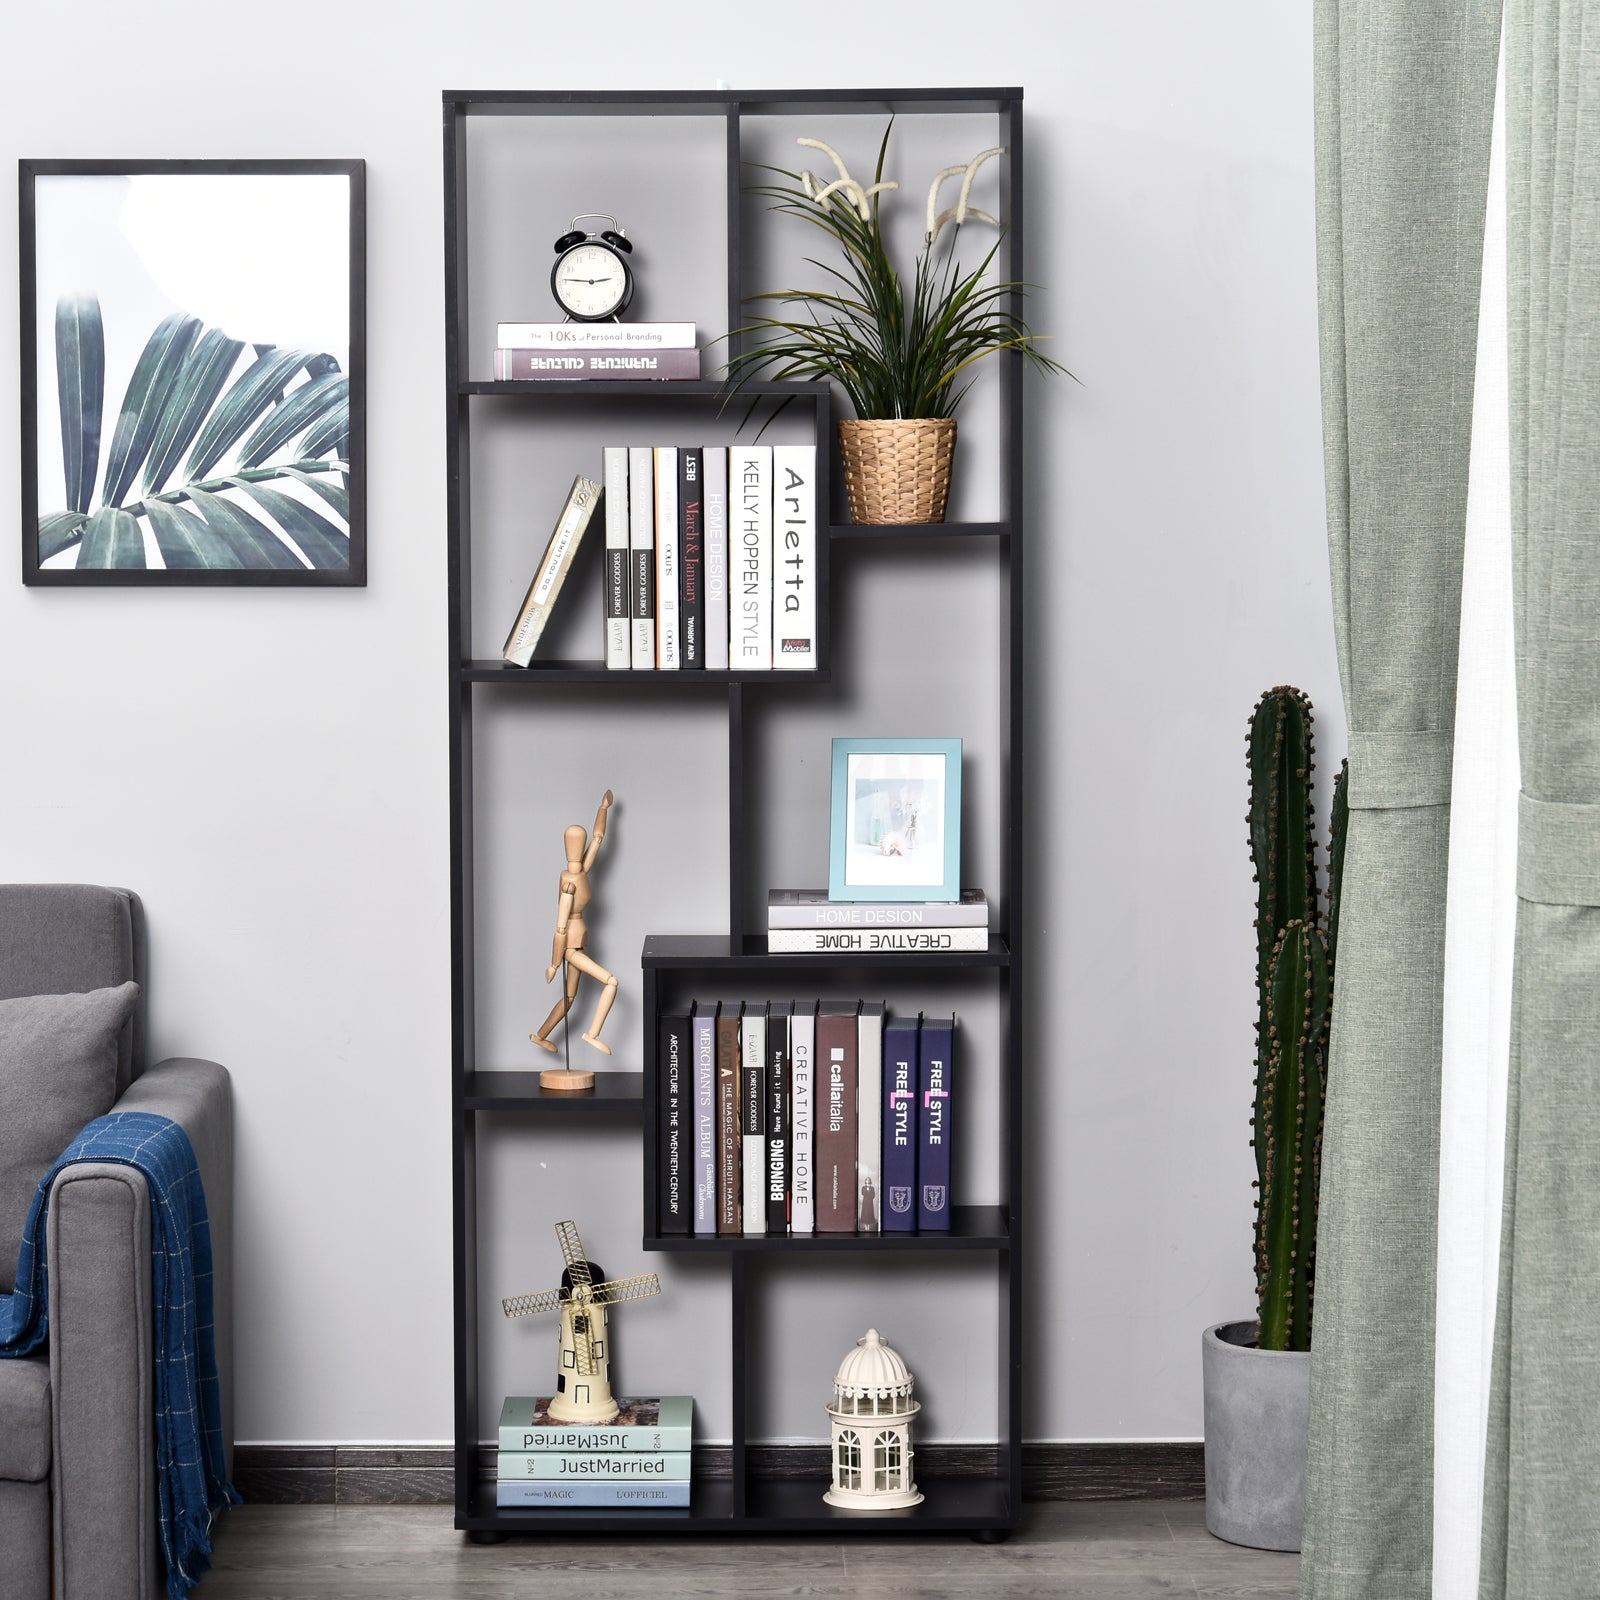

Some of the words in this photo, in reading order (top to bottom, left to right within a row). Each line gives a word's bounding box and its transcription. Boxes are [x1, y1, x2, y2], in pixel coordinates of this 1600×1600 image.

[549, 331, 576, 342] 10Ks
[586, 332, 623, 341] Personal
[626, 332, 662, 342] Branding
[531, 357, 584, 369] CULTURE
[686, 456, 696, 481] BEST
[743, 460, 759, 514] KELLY
[686, 502, 699, 541] March
[710, 494, 722, 538] HOME
[686, 544, 698, 554] &
[743, 520, 759, 594] HOPPEN
[785, 467, 806, 613] Arletta
[542, 578, 550, 591] DO
[549, 560, 558, 576] YOU
[556, 540, 566, 558] LIKE
[564, 529, 571, 538] IT
[710, 543, 722, 600] DESIGN
[684, 556, 699, 604] January
[743, 601, 758, 656] STYLE
[816, 911, 860, 922] HOME
[865, 910, 922, 922] DESIGN
[816, 935, 862, 948] HOME
[870, 935, 951, 948] CREATIVE
[670, 1034, 678, 1094] ARCHITECTURE
[700, 1028, 710, 1106] MERCHANTS
[774, 1051, 782, 1077] lacking
[896, 1062, 908, 1098] FREE
[930, 1060, 942, 1097] FREE
[670, 1098, 678, 1107] IN
[774, 1082, 781, 1090] it
[796, 1046, 808, 1140] CREATIVE
[830, 1064, 844, 1132] caliaitalia
[670, 1110, 678, 1126] THE
[700, 1115, 710, 1158] ALBUM
[896, 1102, 908, 1146] STYLE
[930, 1101, 942, 1144] STYLE
[670, 1130, 678, 1175] TWENTIETH
[726, 1138, 732, 1150] OF
[771, 1139, 784, 1200] BRINGING
[796, 1152, 808, 1204] HOME
[670, 1176, 678, 1214] CENTURY
[524, 1434, 628, 1448] JustMarried
[559, 1458, 664, 1474] JustMarried
[616, 1490, 668, 1498] L'OFFICIEL
